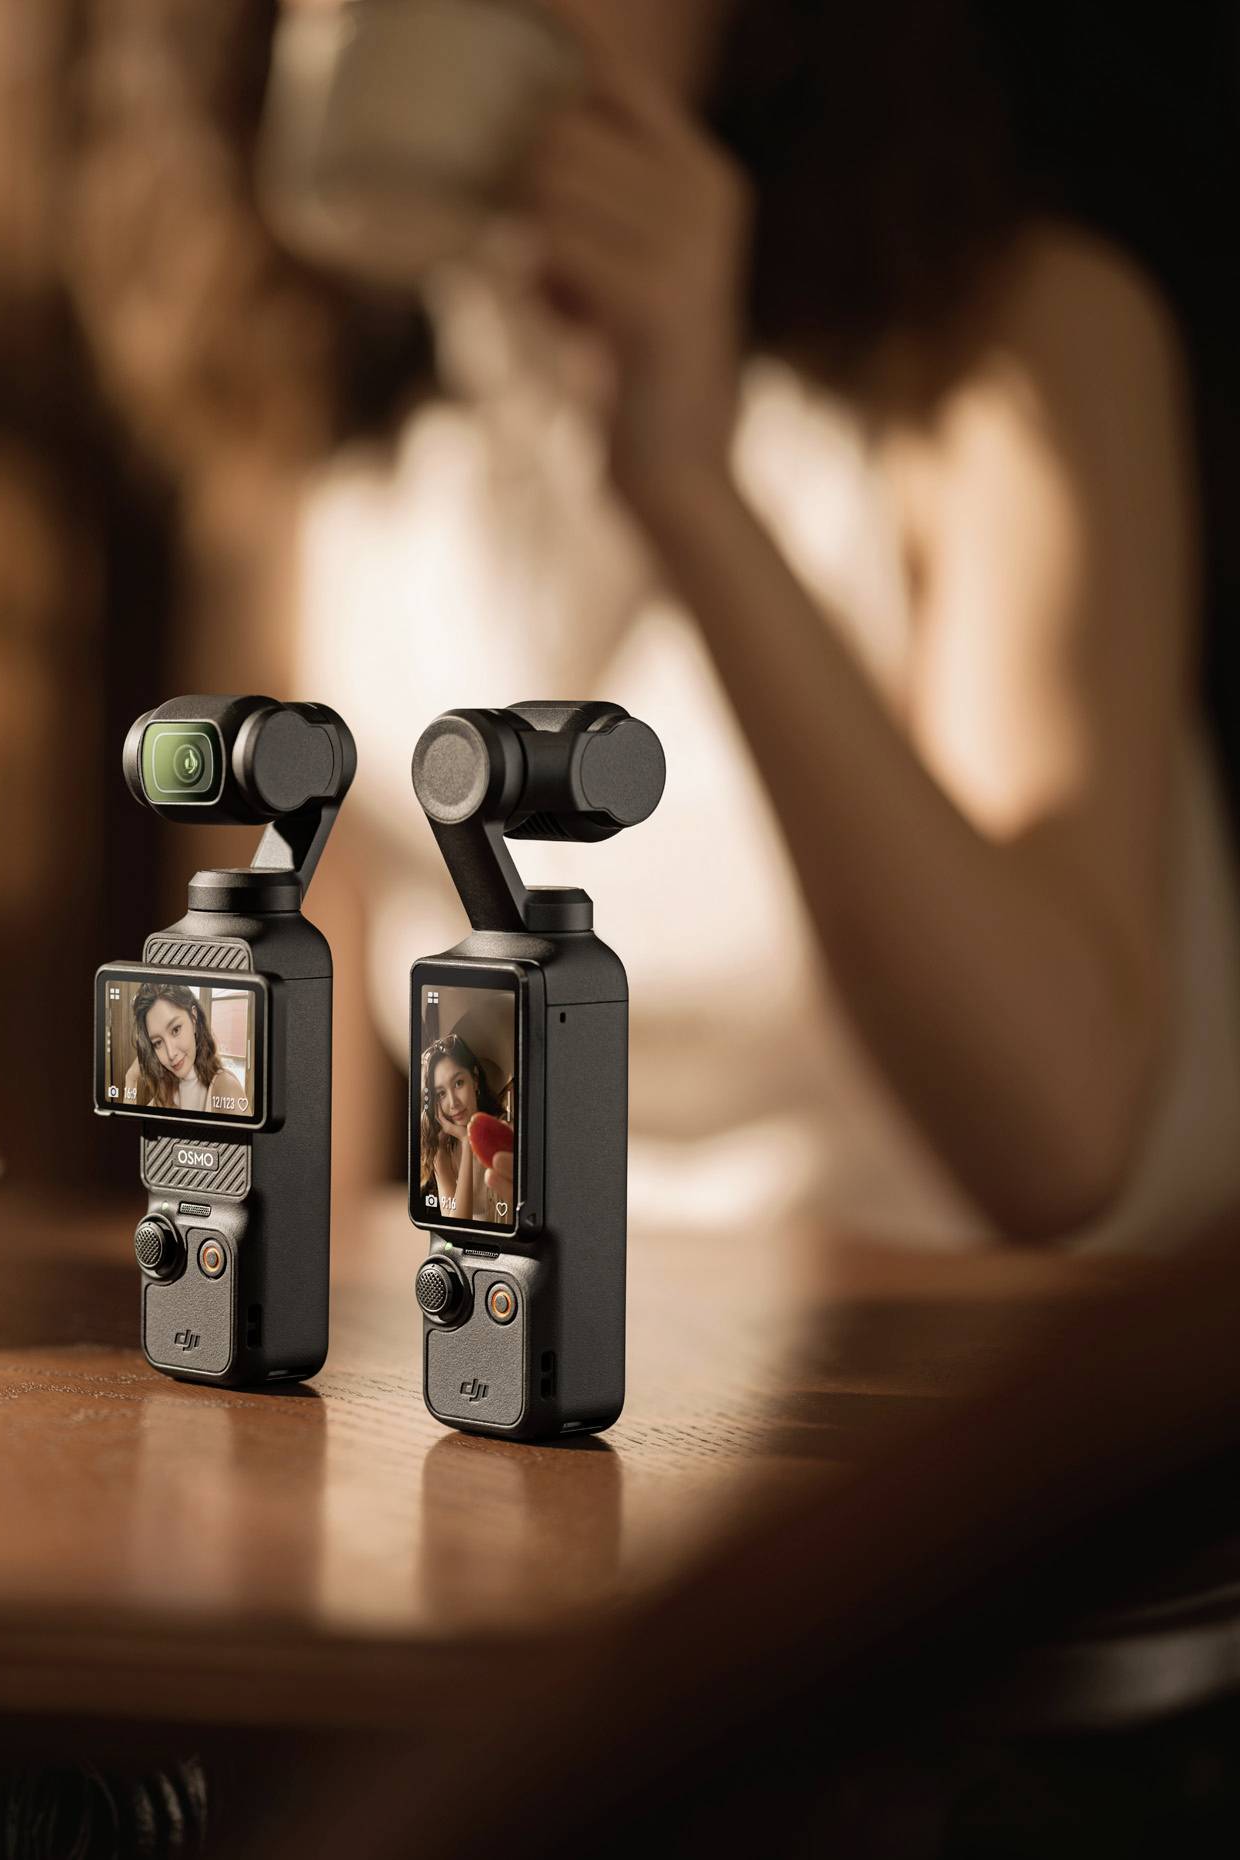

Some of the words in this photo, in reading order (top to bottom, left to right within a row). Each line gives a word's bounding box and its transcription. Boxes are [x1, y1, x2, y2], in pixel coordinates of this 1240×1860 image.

[212, 1096, 235, 1110] 12/123
[178, 1150, 213, 1167] OSMO
[441, 1196, 456, 1210] 9:16
